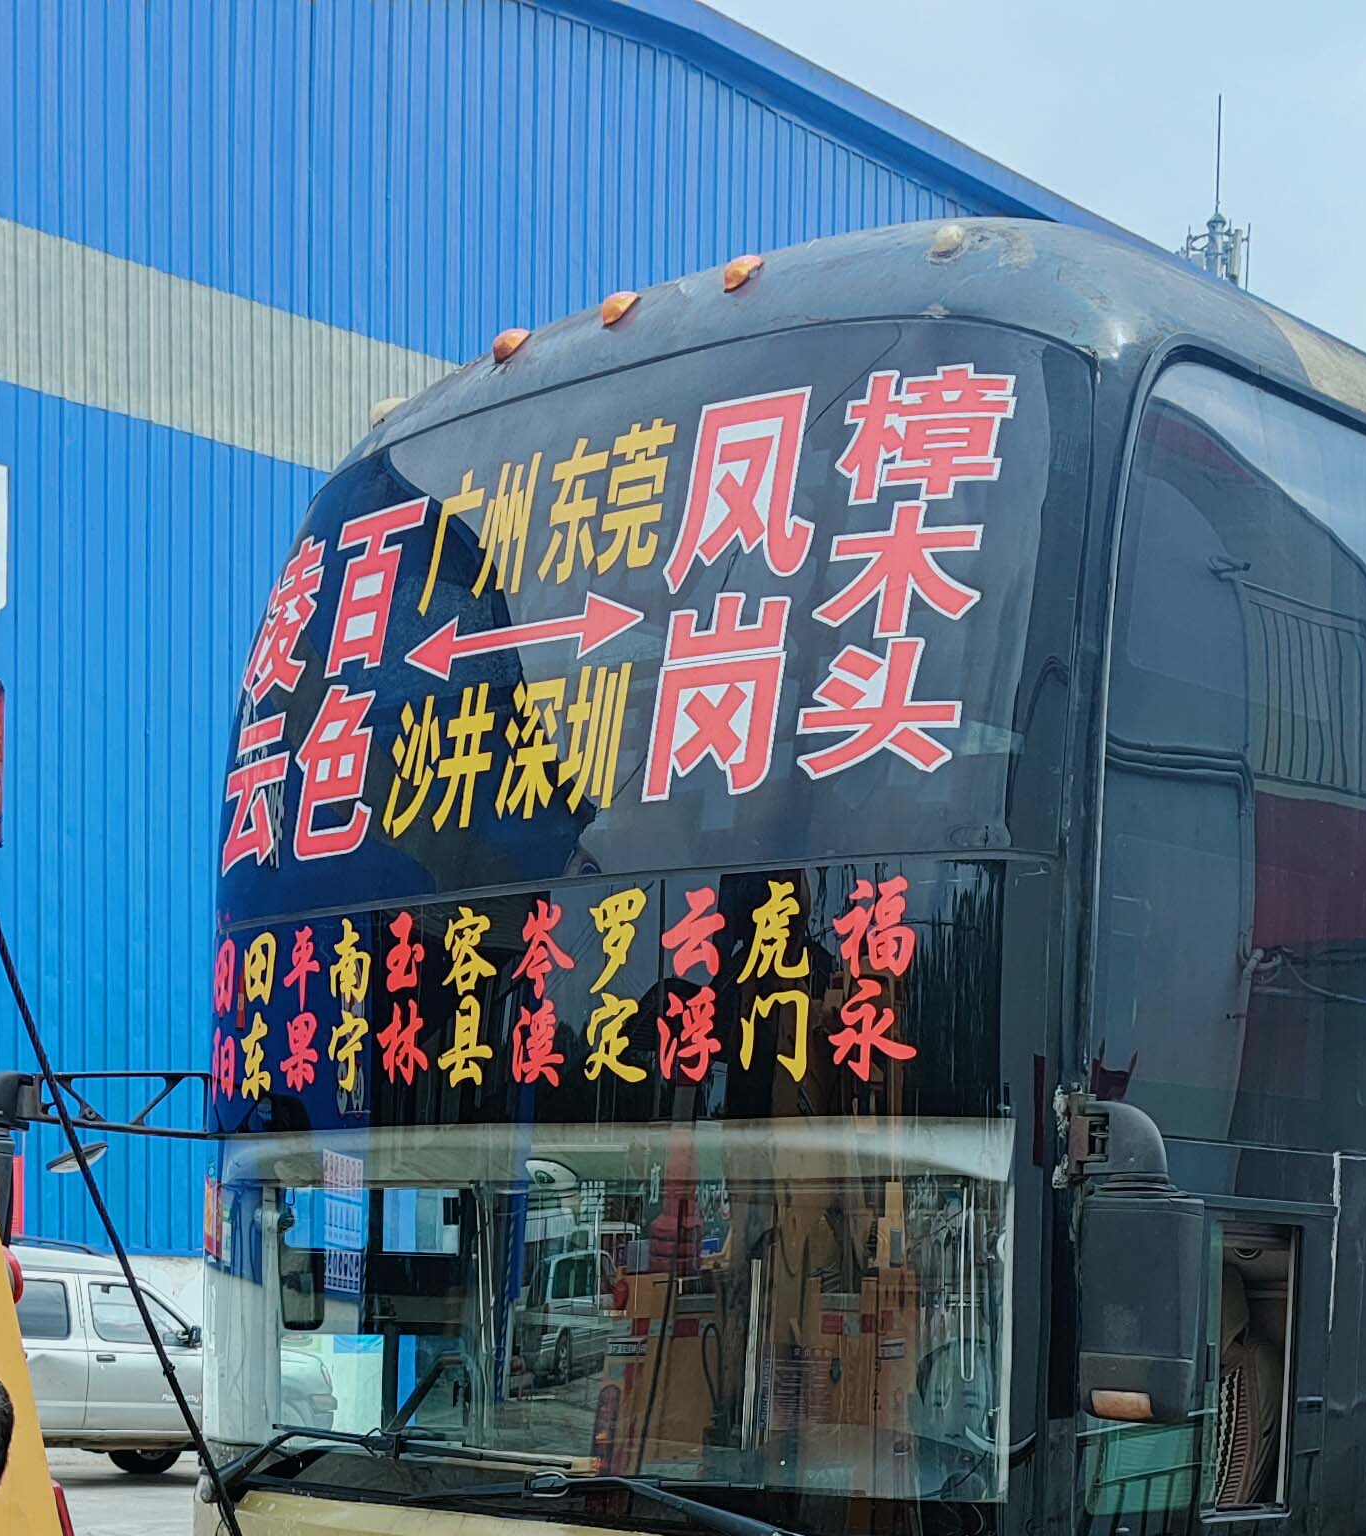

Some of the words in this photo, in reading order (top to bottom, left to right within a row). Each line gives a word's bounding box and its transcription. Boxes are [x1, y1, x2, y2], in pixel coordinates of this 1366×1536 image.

[293, 496, 429, 860] 百色
[642, 385, 816, 802] 凤岗
[795, 362, 1017, 780] 樟木头
